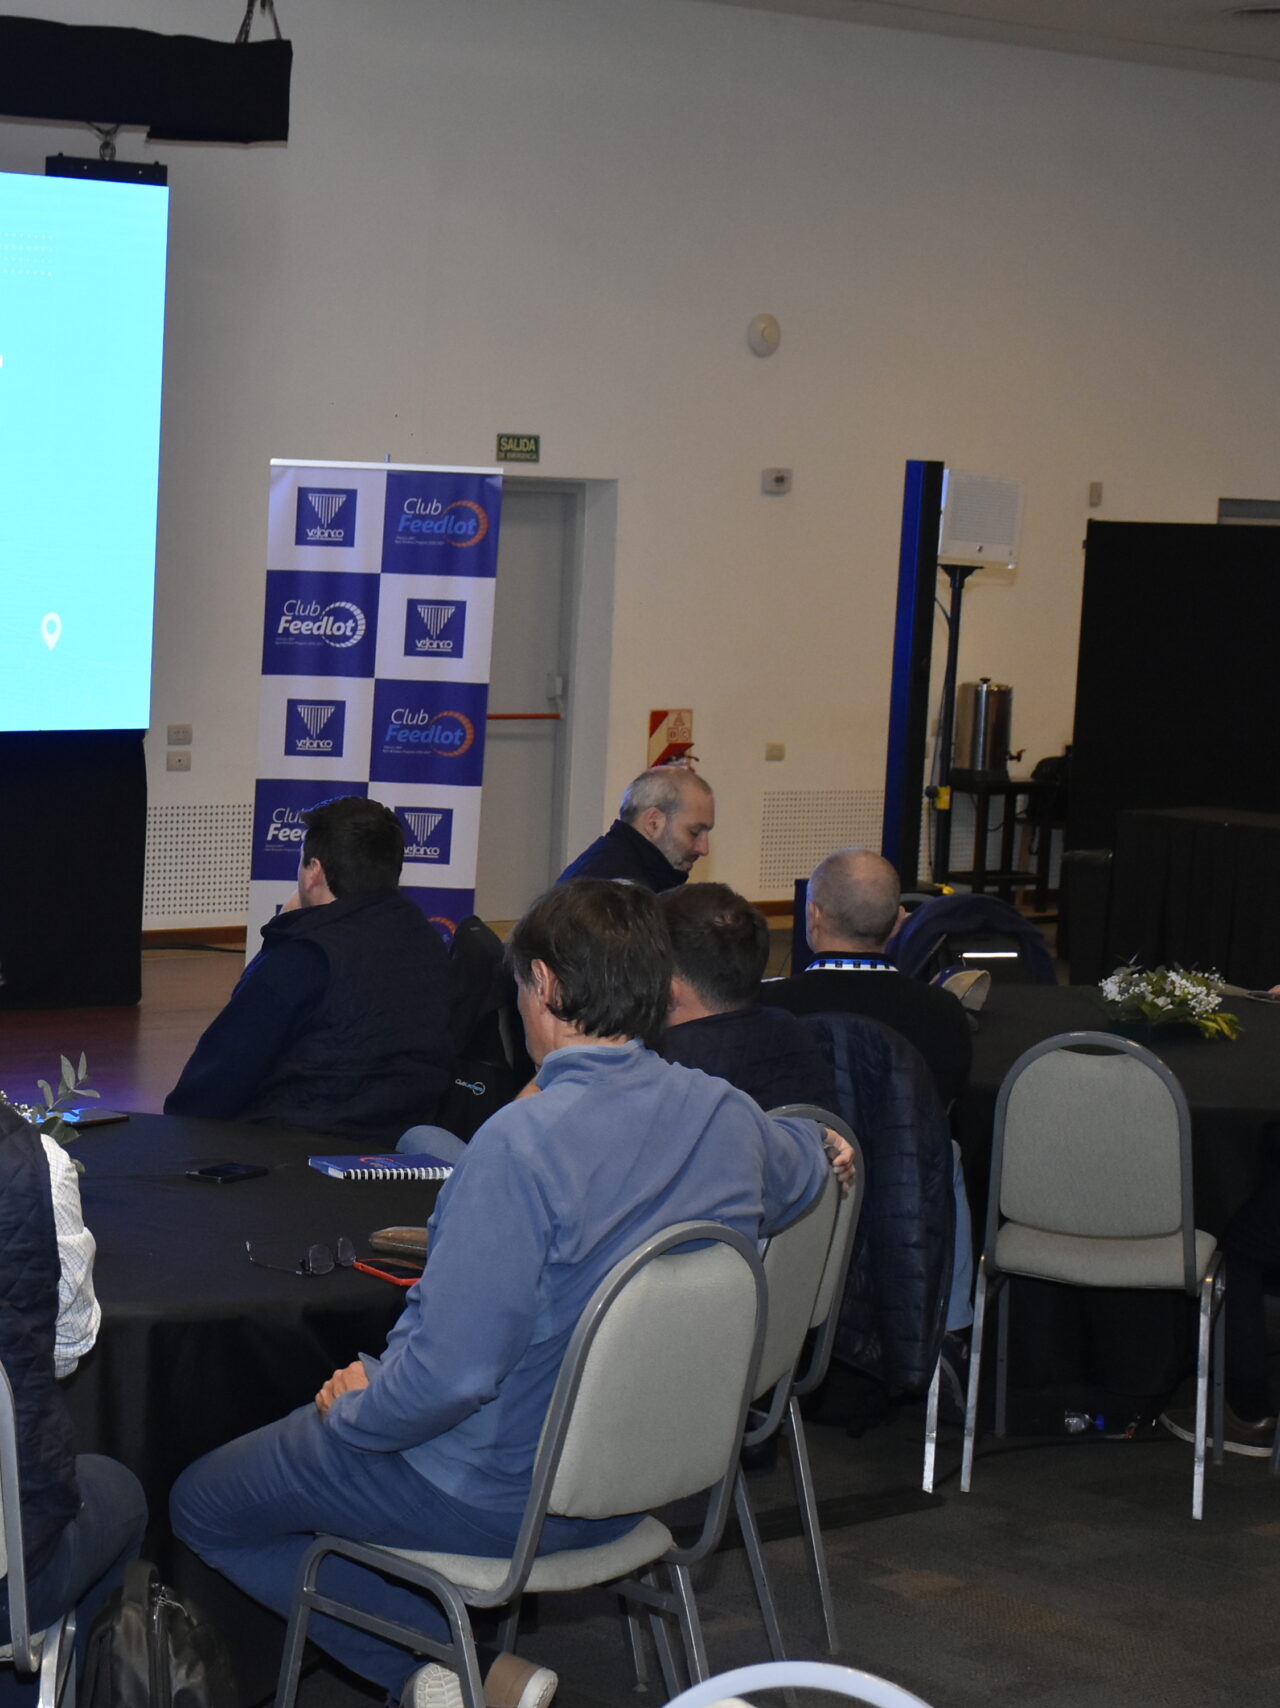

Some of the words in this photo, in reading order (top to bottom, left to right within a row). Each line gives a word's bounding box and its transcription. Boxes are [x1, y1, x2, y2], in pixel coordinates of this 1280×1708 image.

[500, 437, 536, 452] SALIDA
[403, 497, 442, 516] Club
[398, 514, 477, 535] Feedlot
[283, 599, 321, 617] Club
[278, 615, 355, 636] Feedlot
[391, 708, 429, 726] Club
[385, 724, 464, 746] Feedlot
